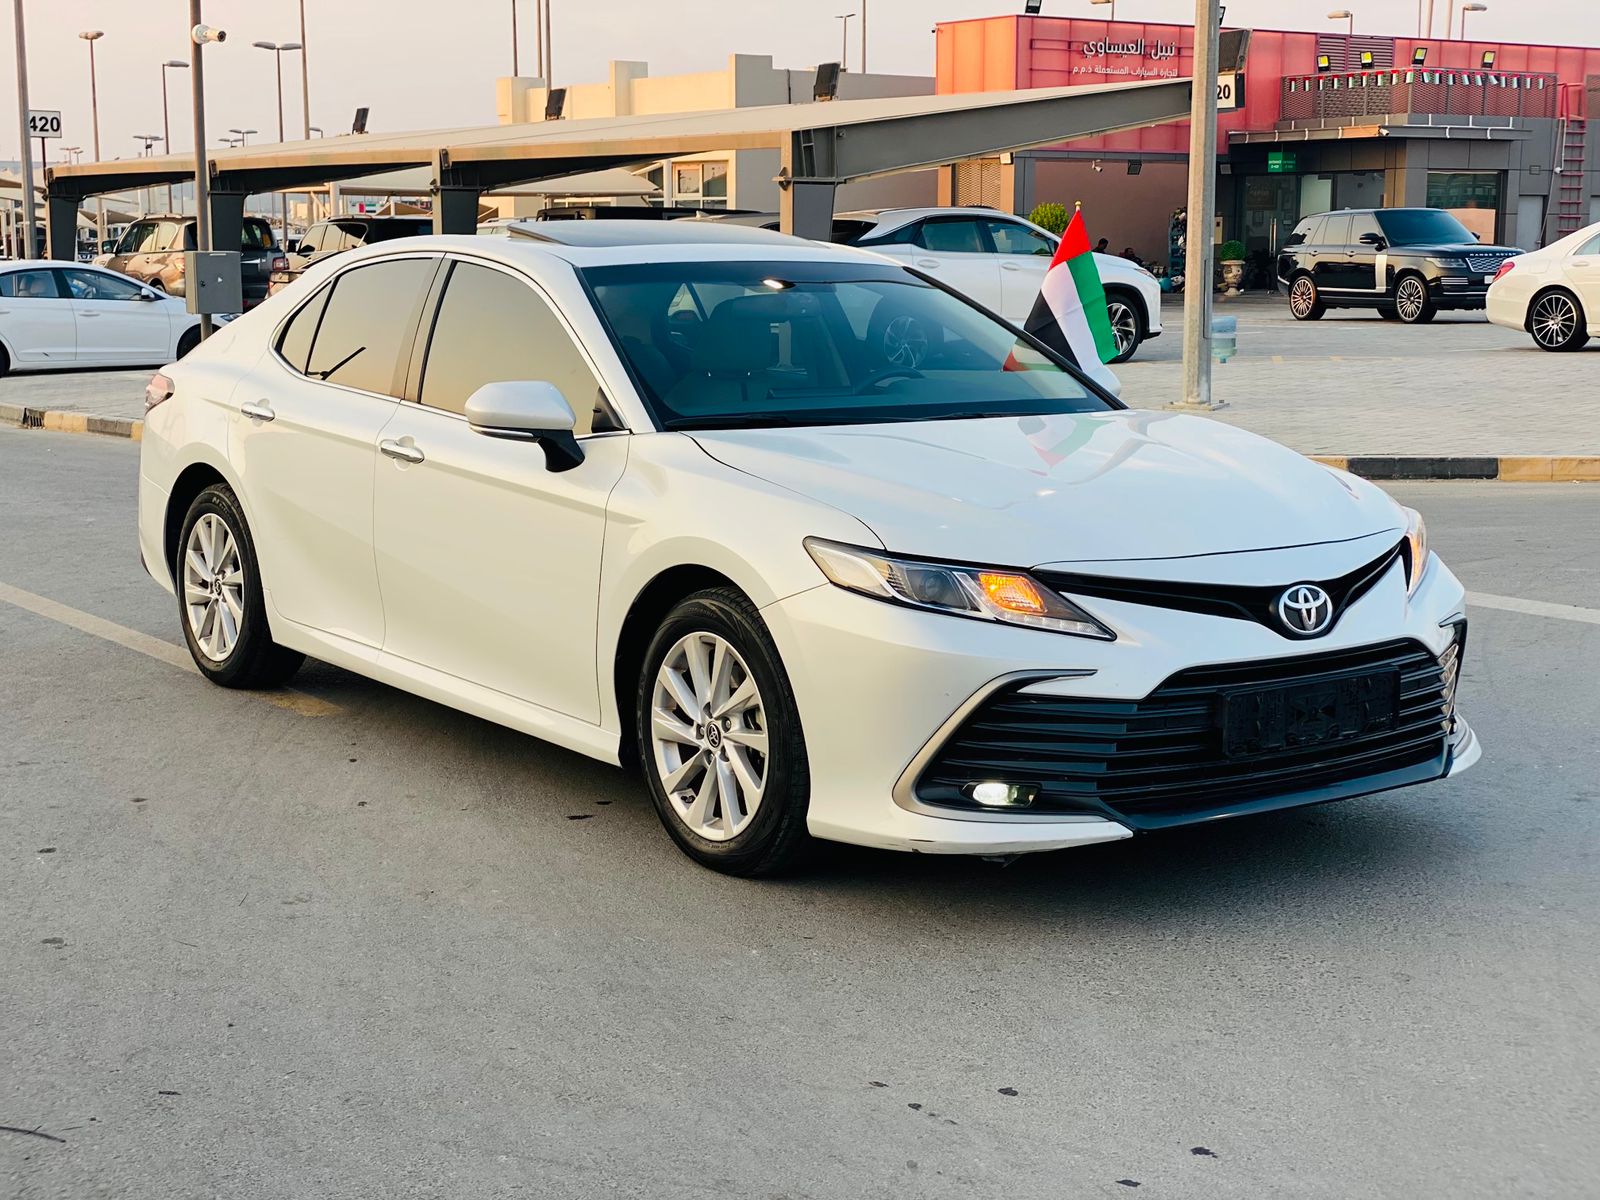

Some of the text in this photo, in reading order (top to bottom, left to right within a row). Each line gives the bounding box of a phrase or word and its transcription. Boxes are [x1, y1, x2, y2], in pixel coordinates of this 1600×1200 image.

[1083, 37, 1175, 60] نبيل العيساوي
[1094, 65, 1129, 75] المستعملة
[1131, 67, 1158, 77] السيارات
[1159, 68, 1178, 78] لتجارة
[29, 115, 61, 132] 420
